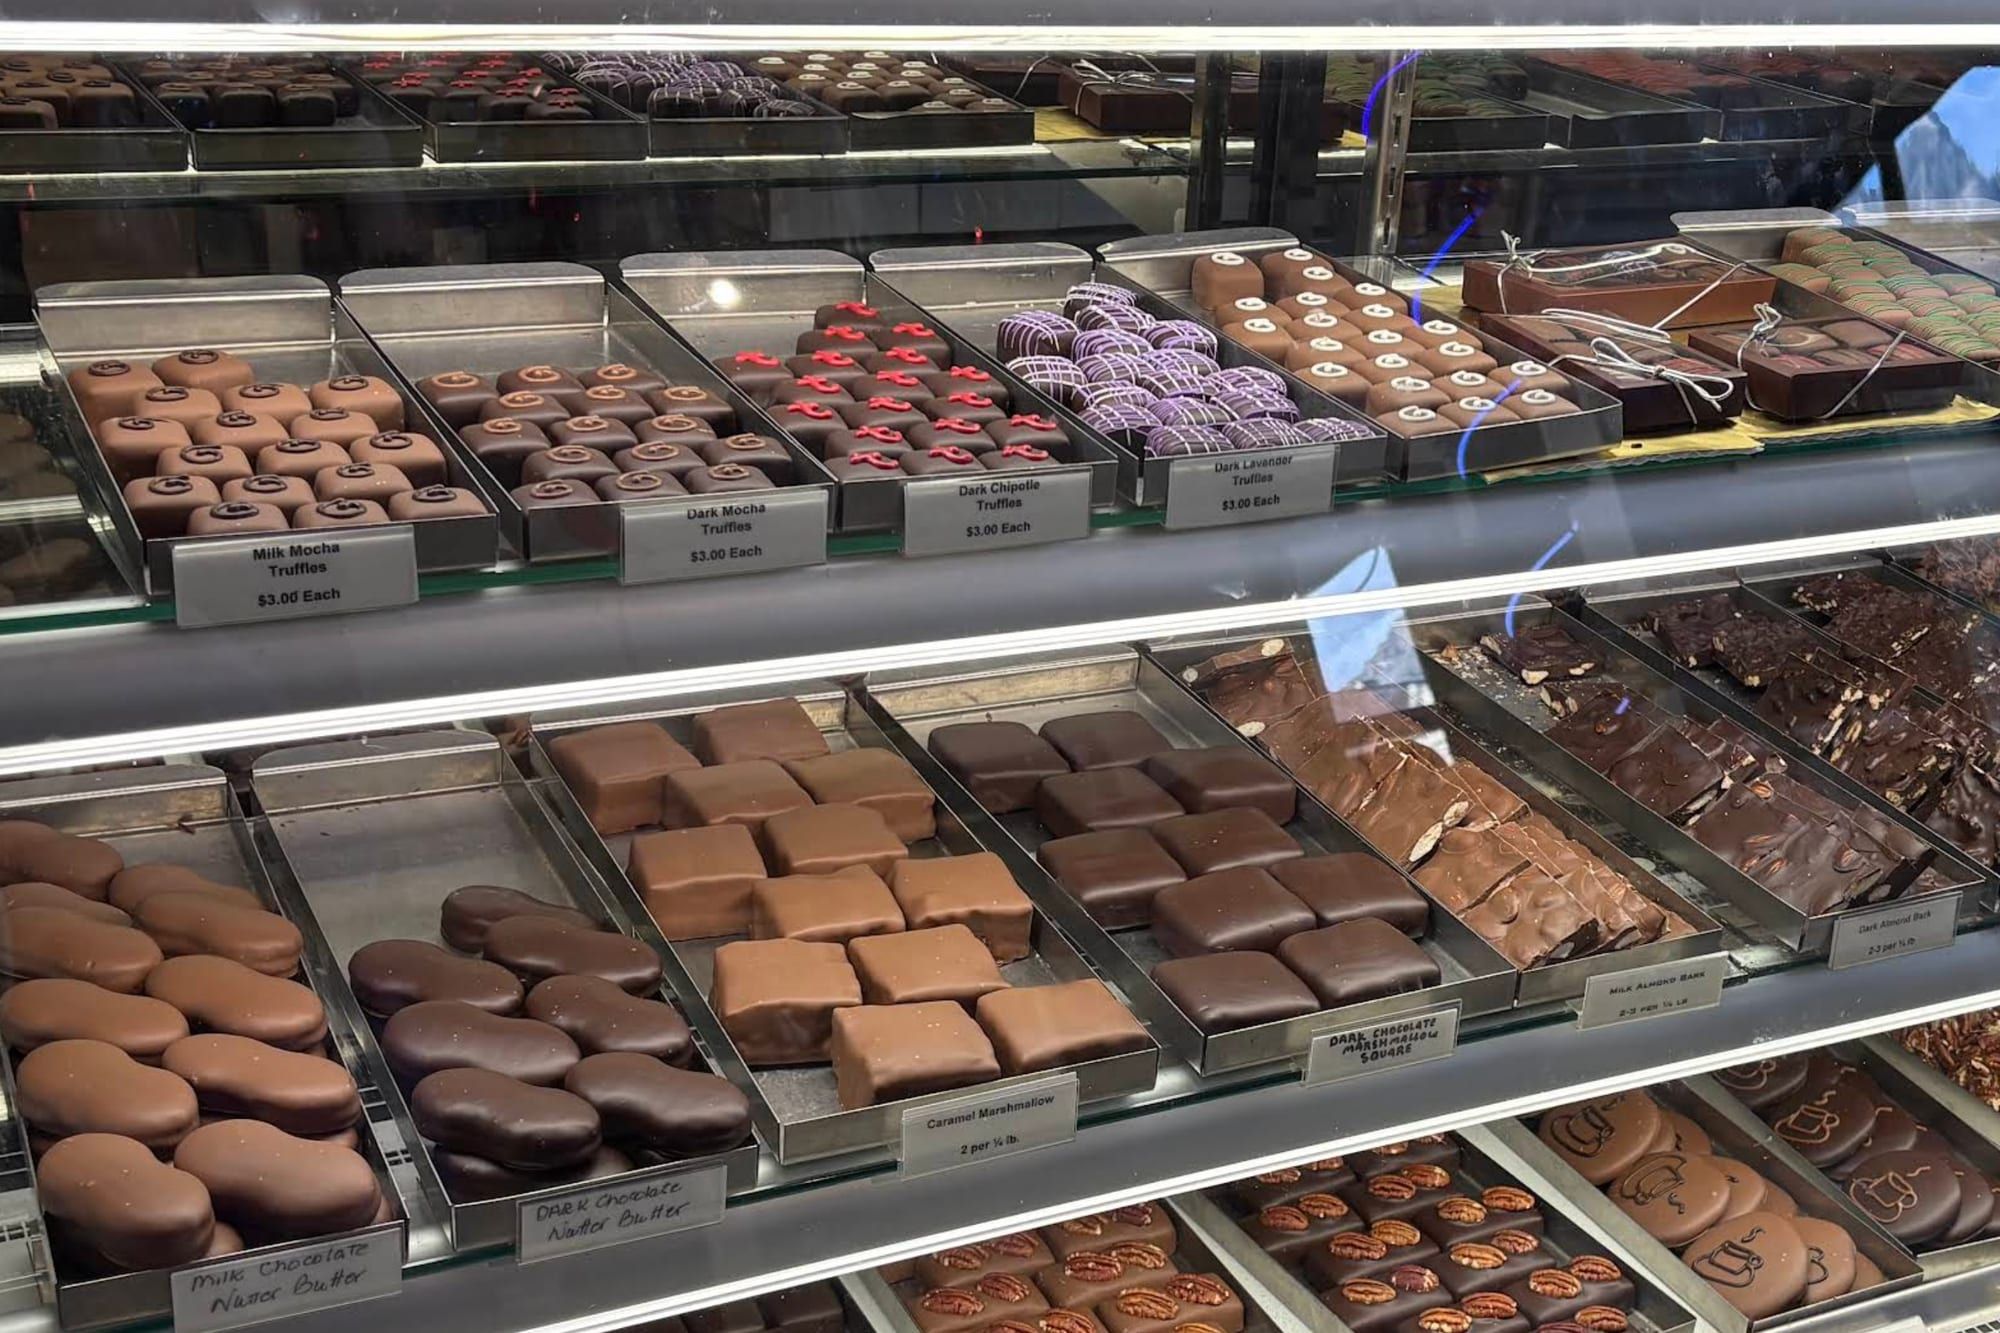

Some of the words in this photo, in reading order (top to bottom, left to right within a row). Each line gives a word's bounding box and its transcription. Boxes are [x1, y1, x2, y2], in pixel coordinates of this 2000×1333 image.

[1215, 461, 1240, 473] Dark
[1243, 455, 1293, 470] Lavender
[959, 483, 988, 497] Dark
[990, 479, 1040, 495] Chipotle
[1232, 473, 1273, 486] Truffles
[976, 498, 1022, 511] Truffles
[1222, 499, 1250, 511] $3.00
[1253, 494, 1280, 507] Each
[687, 508, 719, 520] Dark
[722, 504, 766, 516] Mocha
[701, 521, 752, 536] Truffles
[966, 525, 998, 537] $3.00
[1001, 521, 1031, 533] Each
[253, 547, 285, 561] Milk
[289, 542, 340, 557] Mocha
[691, 549, 726, 563] $3.00
[730, 545, 763, 559] Each
[268, 562, 328, 578] Truffles
[258, 590, 299, 607] $3.00
[303, 588, 341, 603] Each
[1329, 1031, 1367, 1047] DARK
[1373, 1018, 1437, 1039] CHOCOLATE
[1360, 1043, 1413, 1064] SQUARE
[927, 1112, 976, 1129] Caramel
[979, 1095, 1056, 1119] Marshmallow
[960, 1144, 968, 1154] 2
[971, 1141, 990, 1155] per
[536, 1200, 588, 1222] DARK
[259, 1242, 369, 1277] Chocolate
[293, 1268, 368, 1296] Butter
